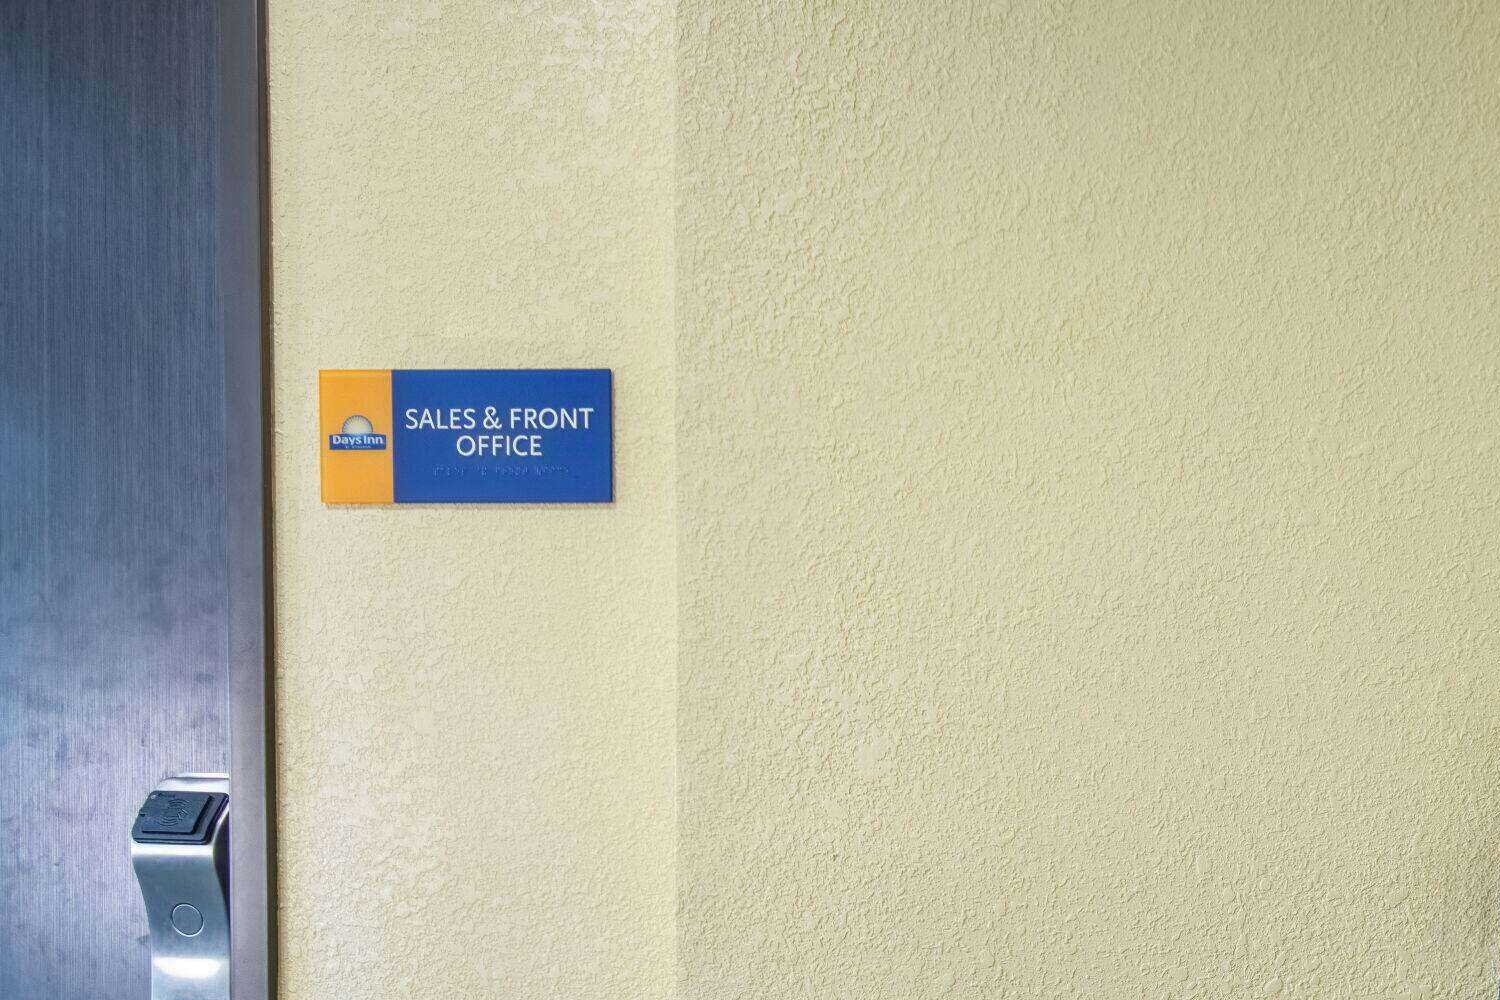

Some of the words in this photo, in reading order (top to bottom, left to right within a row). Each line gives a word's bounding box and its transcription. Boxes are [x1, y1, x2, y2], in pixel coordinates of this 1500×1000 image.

[405, 407, 476, 430] SALES
[482, 406, 503, 430] &
[511, 407, 594, 430] FRONT
[332, 435, 362, 446] Days
[363, 435, 384, 444] Inn
[456, 435, 543, 457] OFFICE
